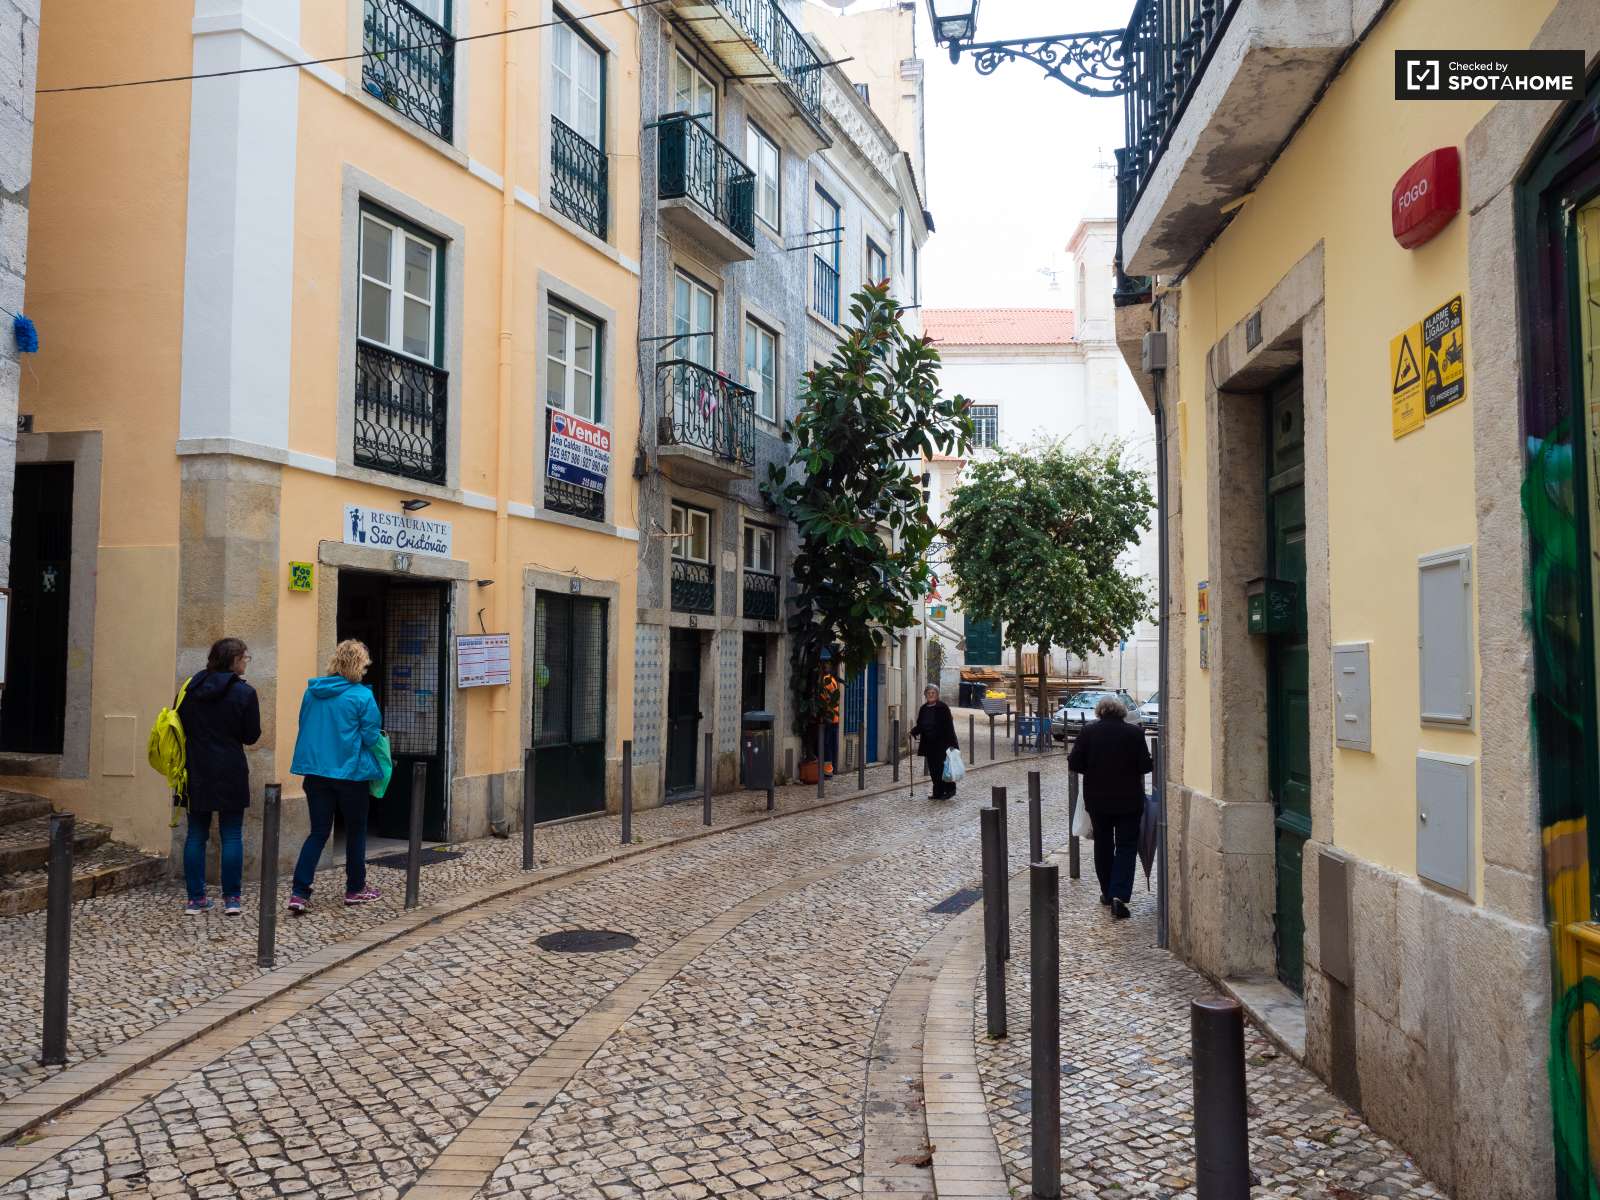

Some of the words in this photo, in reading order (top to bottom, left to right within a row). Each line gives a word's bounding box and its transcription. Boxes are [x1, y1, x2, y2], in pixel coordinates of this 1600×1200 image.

[1398, 179, 1428, 213] FOGO
[1425, 307, 1449, 330] ALARME
[1425, 317, 1450, 341] LIGADO
[551, 434, 563, 446] Ana
[567, 418, 609, 449] Vende
[371, 511, 447, 536] RESTAURANTE
[370, 525, 394, 545] São
[396, 529, 448, 554] Cristóvão
